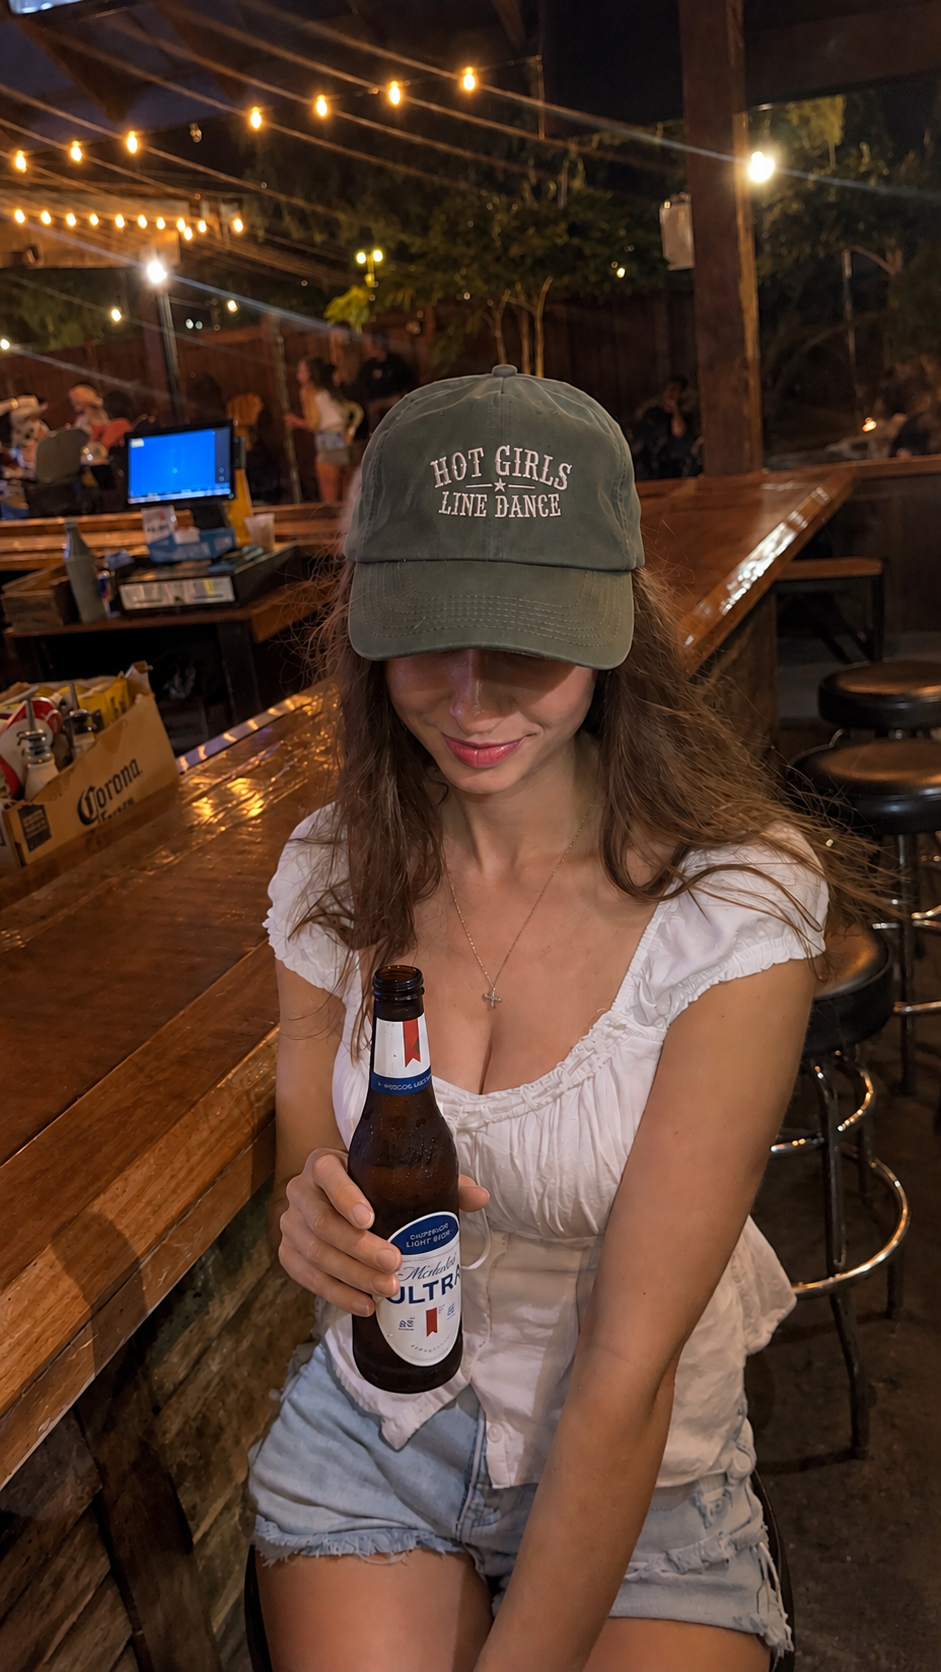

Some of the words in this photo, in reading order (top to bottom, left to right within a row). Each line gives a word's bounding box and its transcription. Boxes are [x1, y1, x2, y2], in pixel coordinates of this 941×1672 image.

[430, 447, 485, 488] HOT
[495, 444, 573, 491] GIRLS
[438, 491, 488, 517] LINE
[494, 493, 562, 518] DANCE
[77, 757, 142, 826] Corona
[405, 1236, 432, 1248] LIGHT
[386, 1263, 461, 1305] ULTRA
